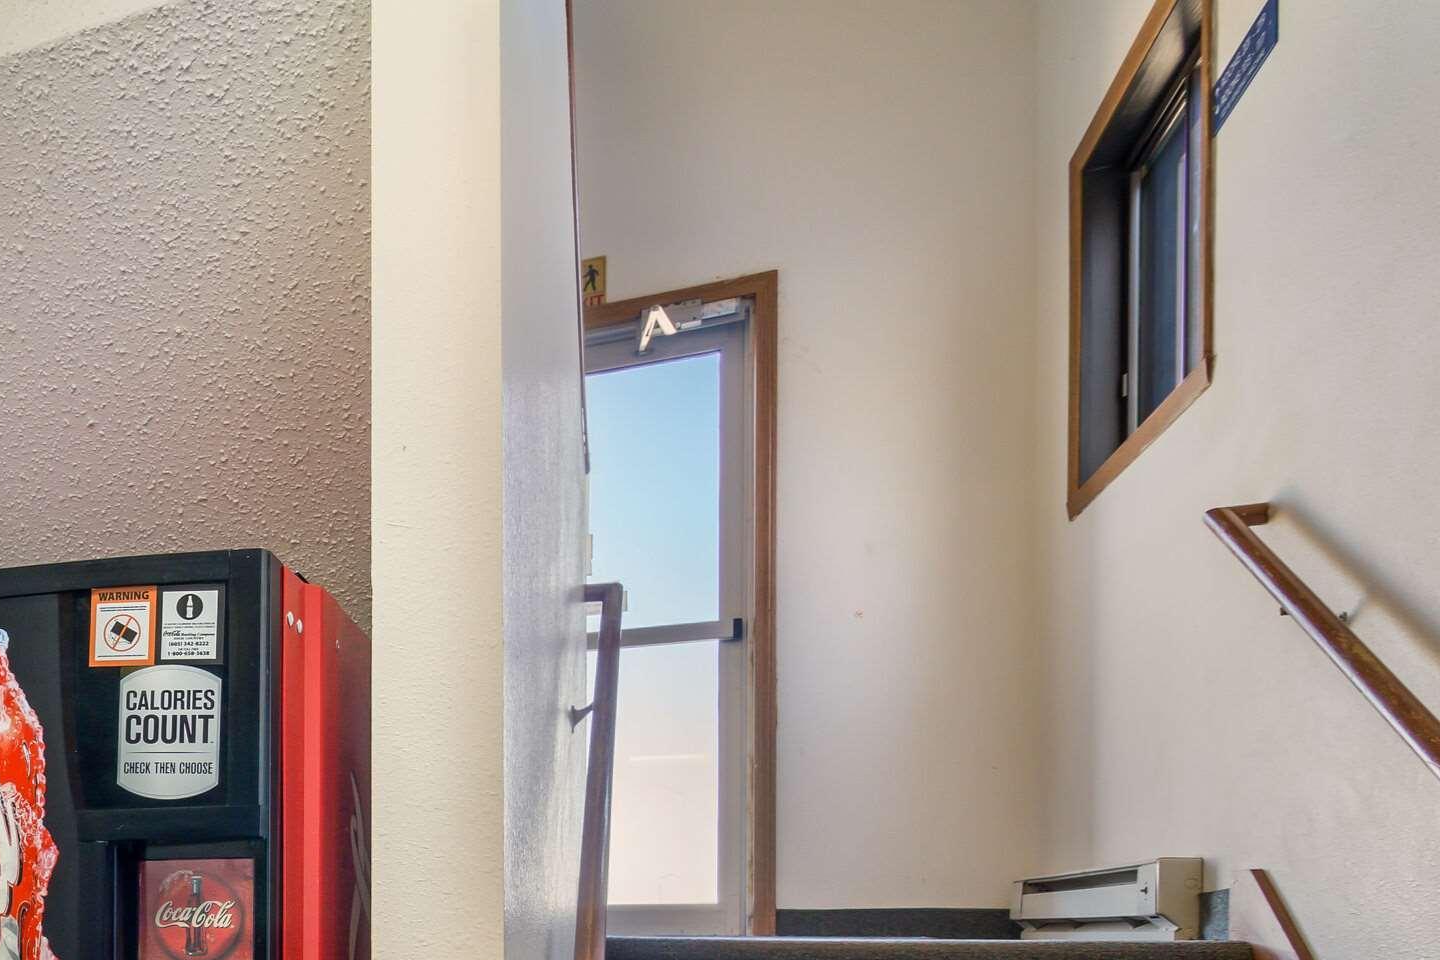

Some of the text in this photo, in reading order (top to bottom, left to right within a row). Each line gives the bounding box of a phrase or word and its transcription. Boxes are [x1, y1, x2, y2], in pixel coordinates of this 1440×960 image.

[98, 590, 150, 601] WARNING
[125, 689, 216, 712] CALORIES
[124, 714, 215, 745] COUNT
[123, 761, 214, 775] CHECK THEN CHOOSE
[154, 897, 237, 928] Coca-Cola
